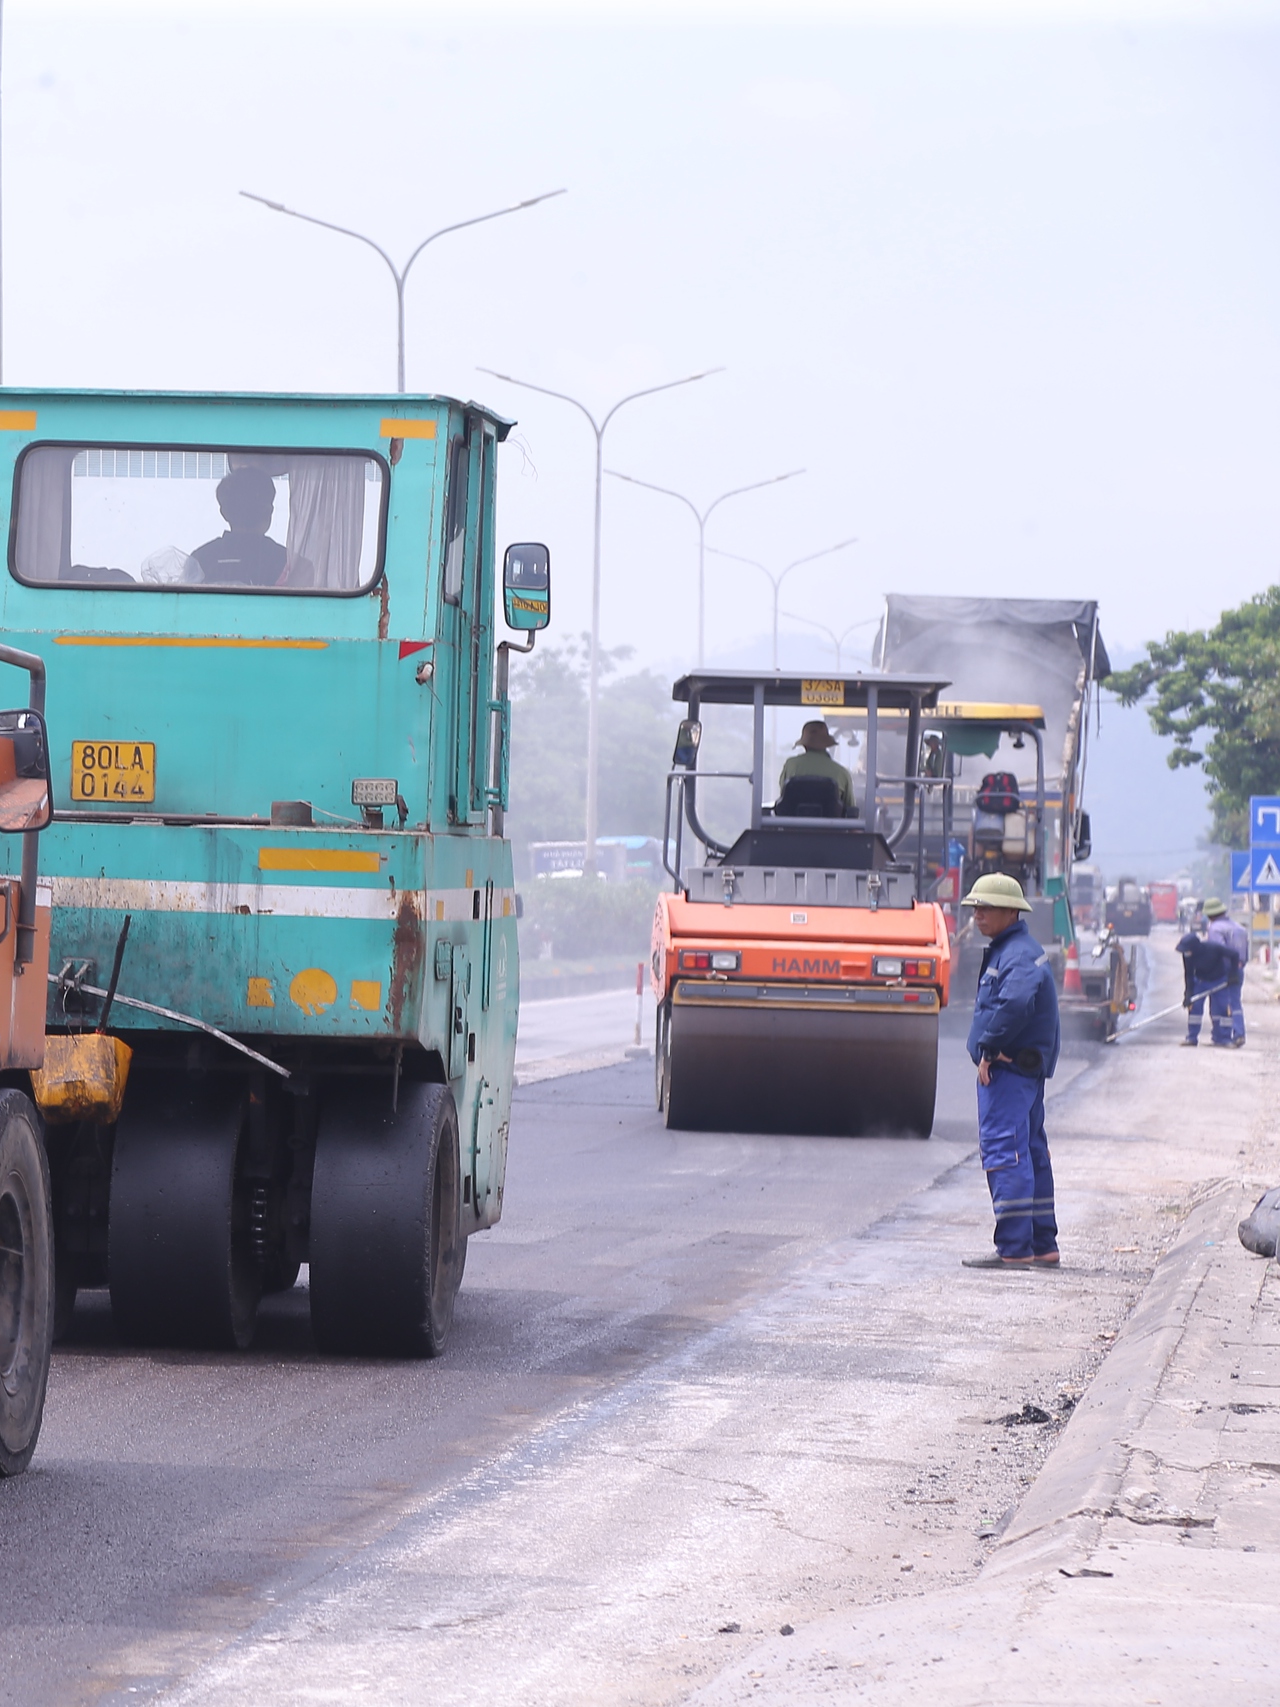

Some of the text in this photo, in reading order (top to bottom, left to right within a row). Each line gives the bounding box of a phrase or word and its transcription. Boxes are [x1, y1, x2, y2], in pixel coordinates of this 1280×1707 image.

[81, 745, 145, 771] 80LA
[81, 773, 145, 798] 0144
[772, 957, 841, 975] HAMM
